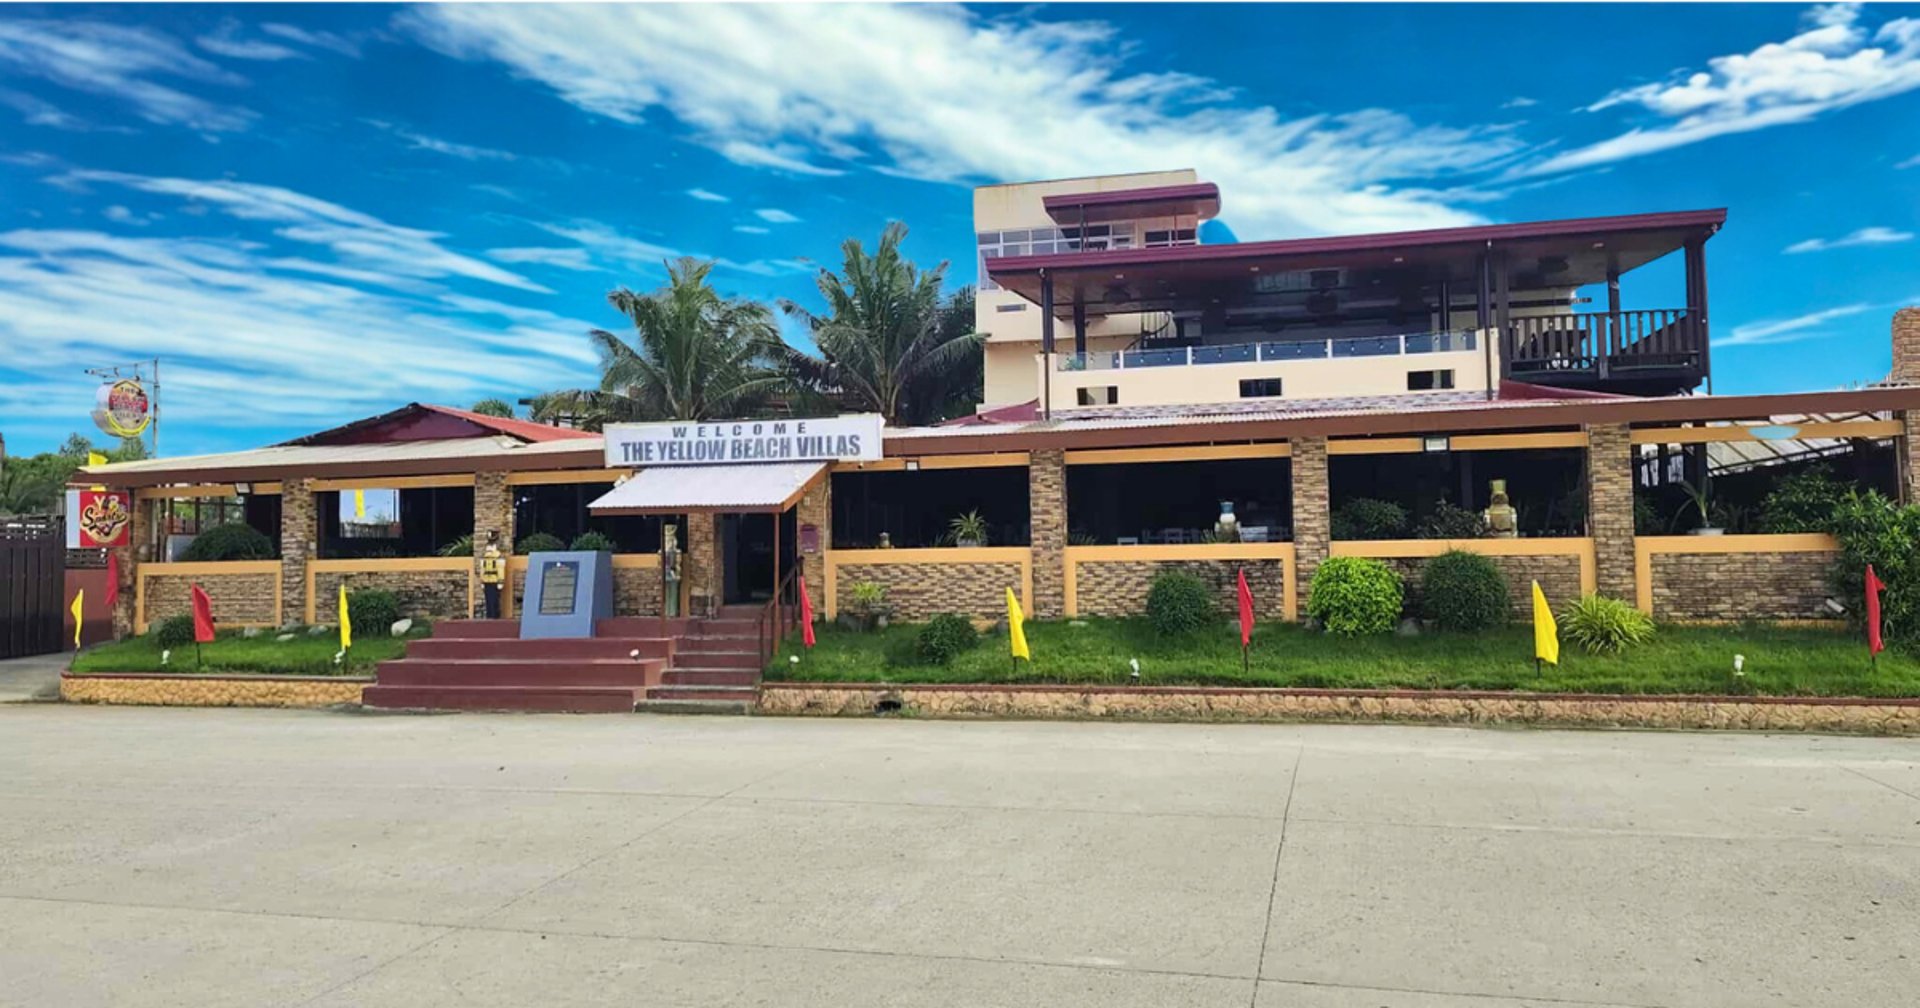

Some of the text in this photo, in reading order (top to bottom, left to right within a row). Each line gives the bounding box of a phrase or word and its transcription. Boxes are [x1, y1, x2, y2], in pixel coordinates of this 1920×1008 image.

[671, 422, 807, 438] WELCOME
[620, 434, 861, 462] THE YELLOW BEACH VILLAS
